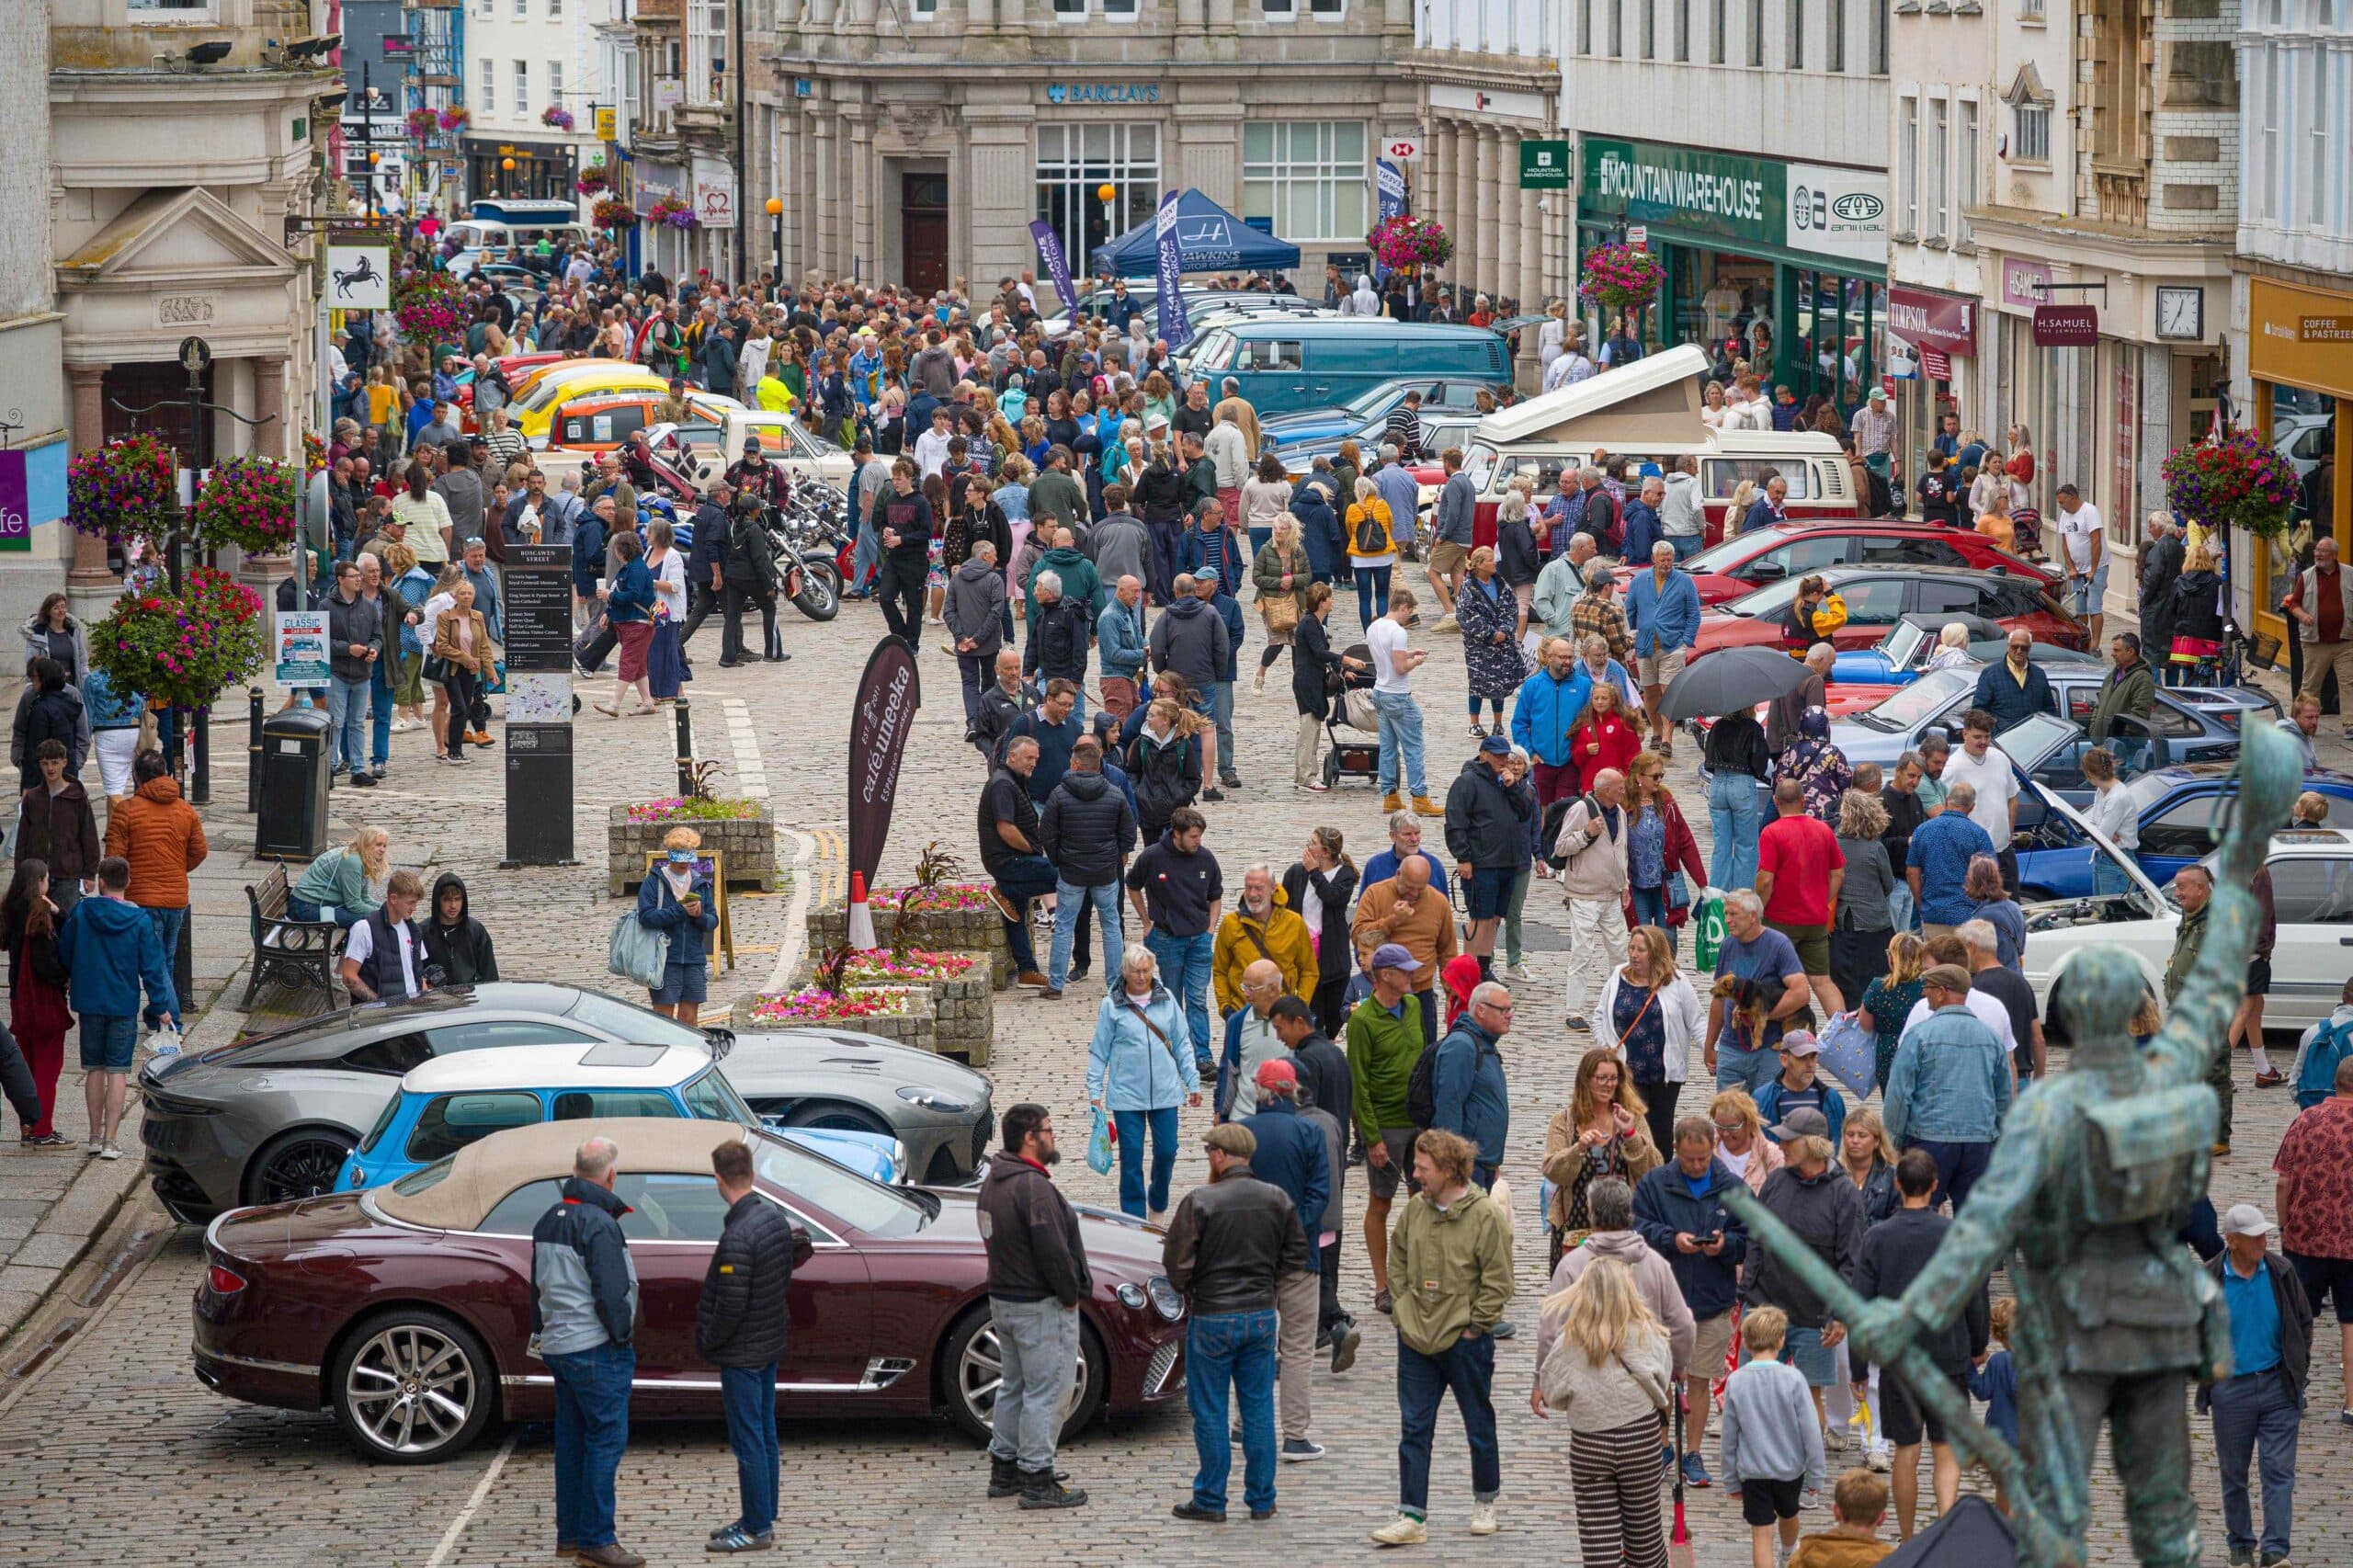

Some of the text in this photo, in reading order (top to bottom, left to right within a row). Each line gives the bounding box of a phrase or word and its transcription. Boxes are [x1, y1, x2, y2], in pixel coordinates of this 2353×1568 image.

[1070, 85, 1160, 102] BARCLAYS
[1608, 160, 1763, 222] MOUNTAIN WAREHOUSE
[1159, 204, 1176, 222] EVENT
[1182, 262, 1208, 270] OTOR
[1890, 302, 1927, 333] TIMPSON
[2038, 318, 2092, 328] H.SAMUEL
[2303, 319, 2337, 328] COFFEE
[2303, 330, 2310, 338] &
[284, 619, 320, 628] CLASSIC
[861, 687, 881, 744] EST. 2011
[863, 665, 910, 804] café.uneeka
[880, 753, 899, 802] ESPRESSO
